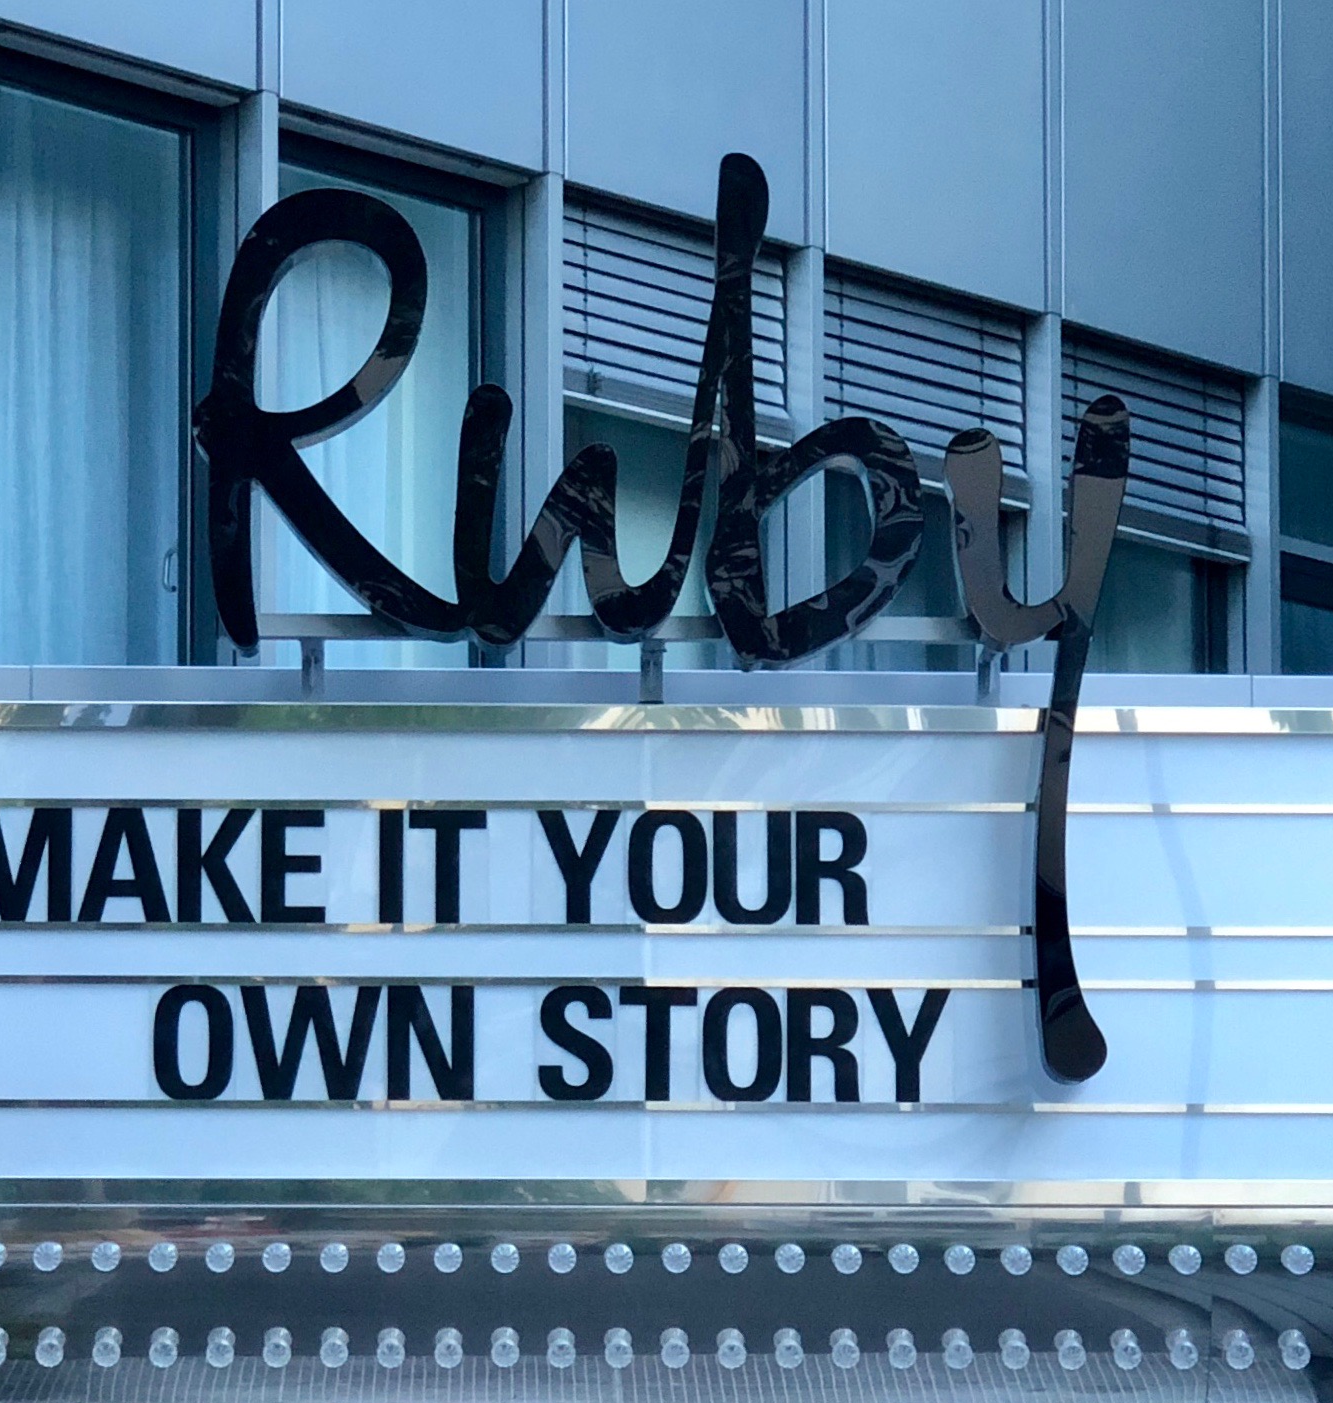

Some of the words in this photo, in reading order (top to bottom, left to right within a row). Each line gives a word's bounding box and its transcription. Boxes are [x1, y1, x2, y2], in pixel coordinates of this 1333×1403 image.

[194, 152, 1131, 1084] Ruby
[378, 808, 488, 924] IT
[537, 809, 870, 925] YOUR
[152, 984, 476, 1101] OWN
[538, 985, 951, 1103] STORY
